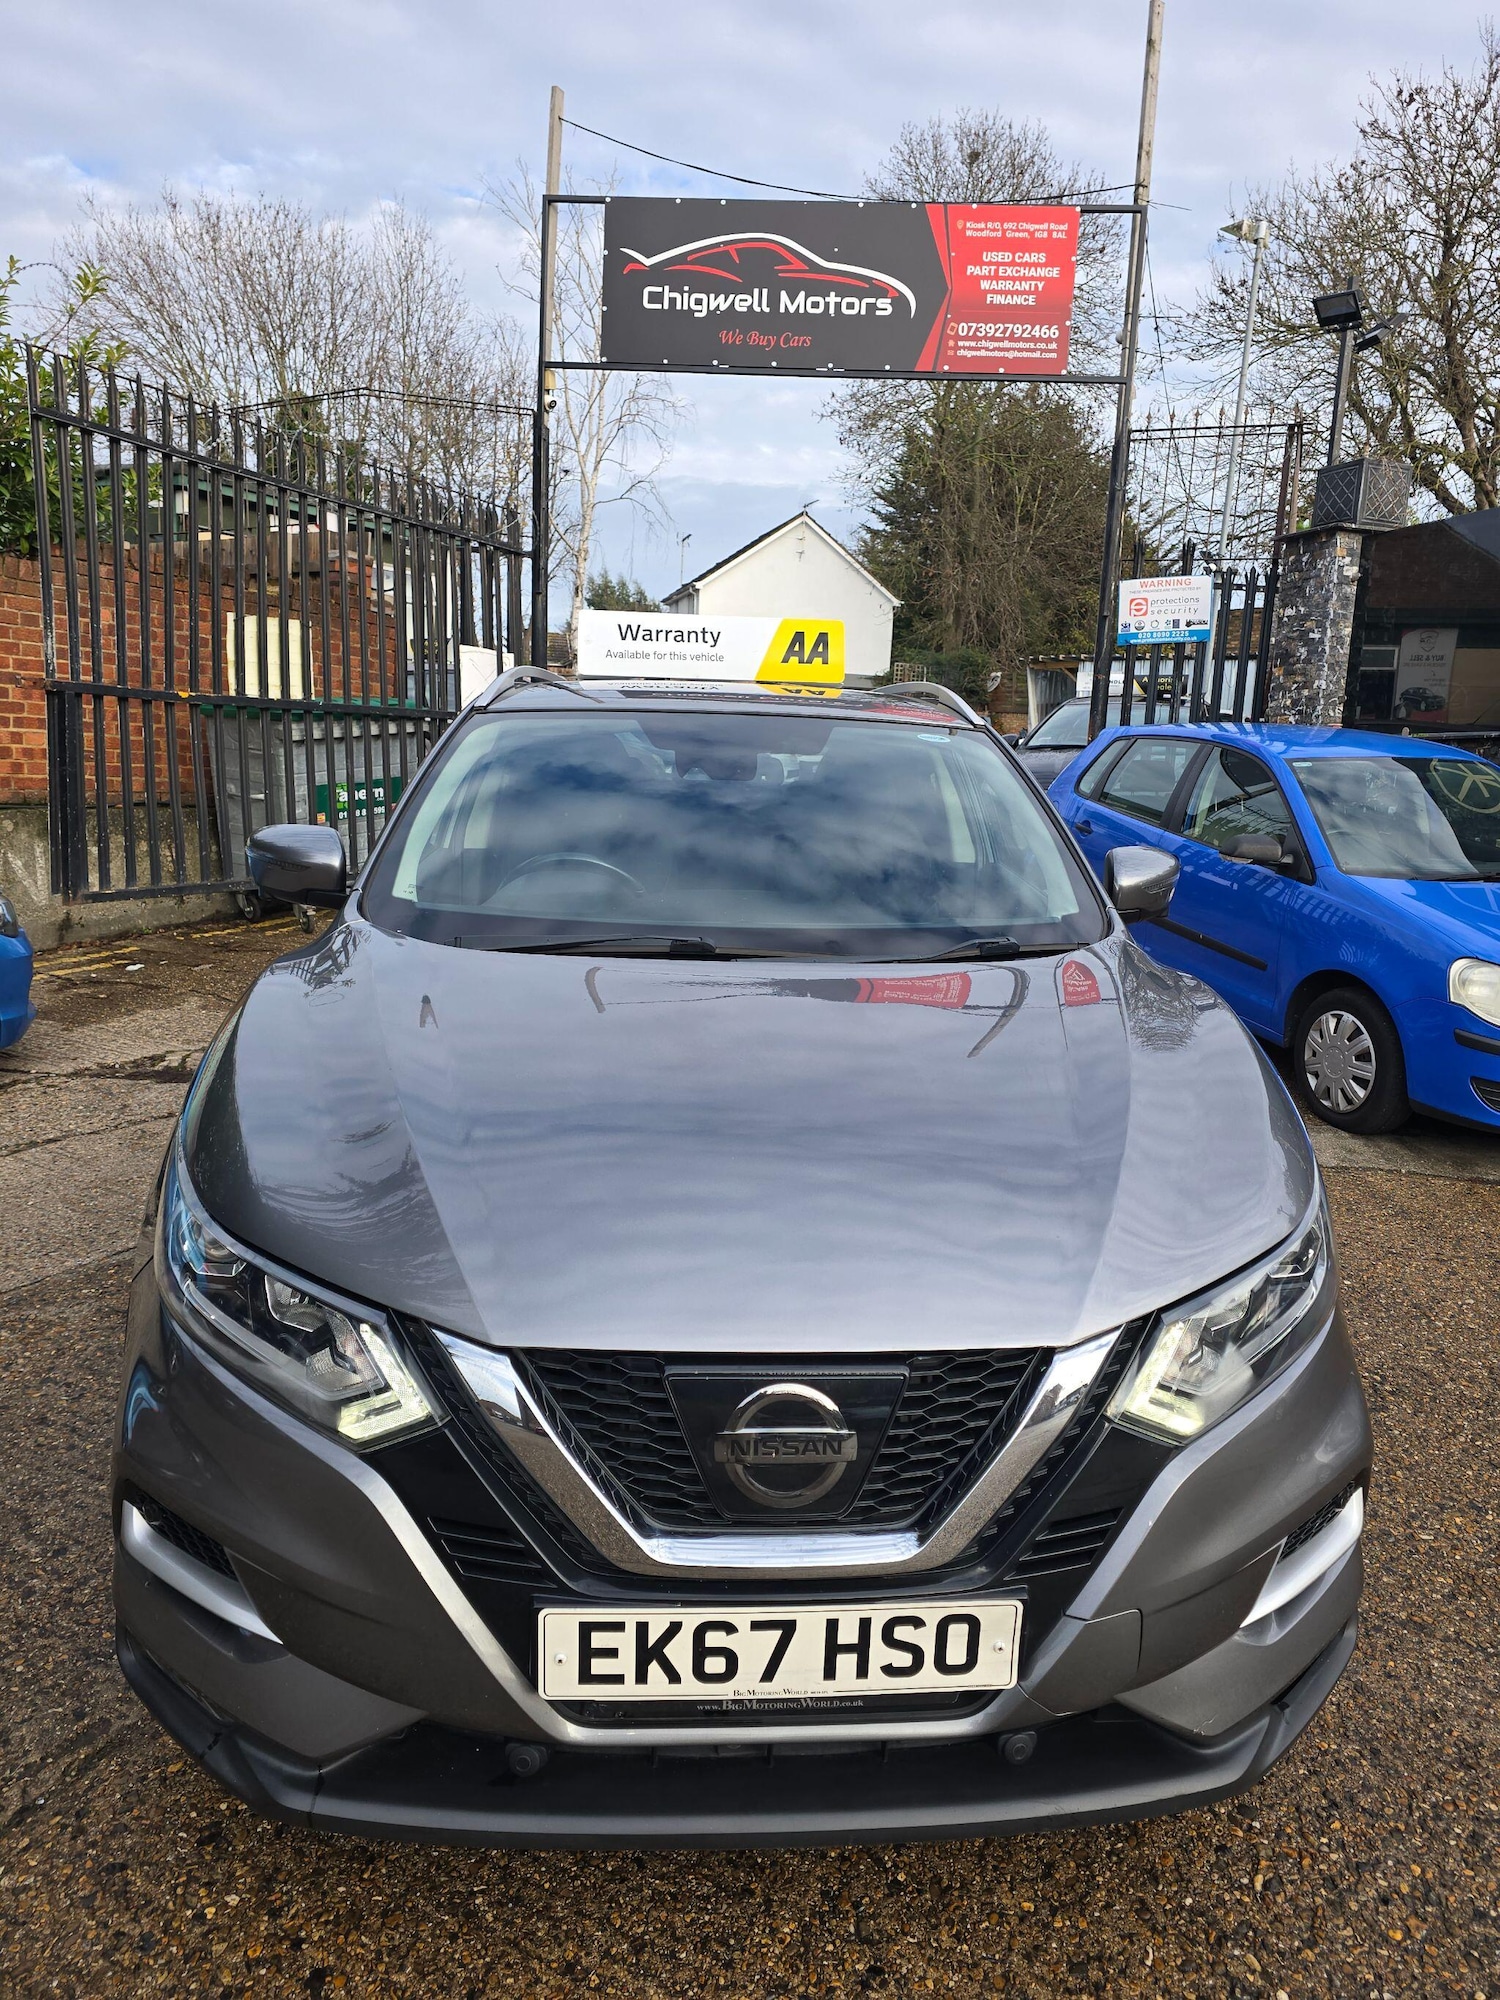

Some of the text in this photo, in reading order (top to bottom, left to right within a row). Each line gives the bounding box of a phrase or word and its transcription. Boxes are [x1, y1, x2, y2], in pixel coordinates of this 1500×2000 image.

[966, 221, 986, 229] Kiosk
[1003, 222, 1017, 230] 692
[1018, 222, 1048, 231] Chigwell
[1006, 230, 1030, 239] Green,
[1035, 231, 1048, 239] IG8
[1052, 231, 1067, 239] 8AL
[982, 252, 1047, 263] USED CARS
[966, 265, 1061, 277] PART EXCHANGE
[980, 280, 1045, 291] WARRANTY
[642, 285, 893, 318] Chigwell Motors
[986, 294, 1037, 306] FINANCE
[957, 323, 1059, 338] 07392792466
[719, 329, 812, 350] We Buy Cars
[957, 340, 1058, 350] www.chigwellmotors.co.uk
[957, 349, 1057, 359] chigwellmotors@hotmail.com
[1139, 578, 1192, 589] WARNING
[1150, 596, 1200, 607] protections
[1150, 606, 1199, 615] security
[618, 624, 721, 647] Warranty
[781, 631, 829, 665] AA
[605, 649, 725, 662] Available for this vehicle
[730, 1439, 843, 1457] NISSAN
[577, 1613, 982, 1686] EK67 HSO
